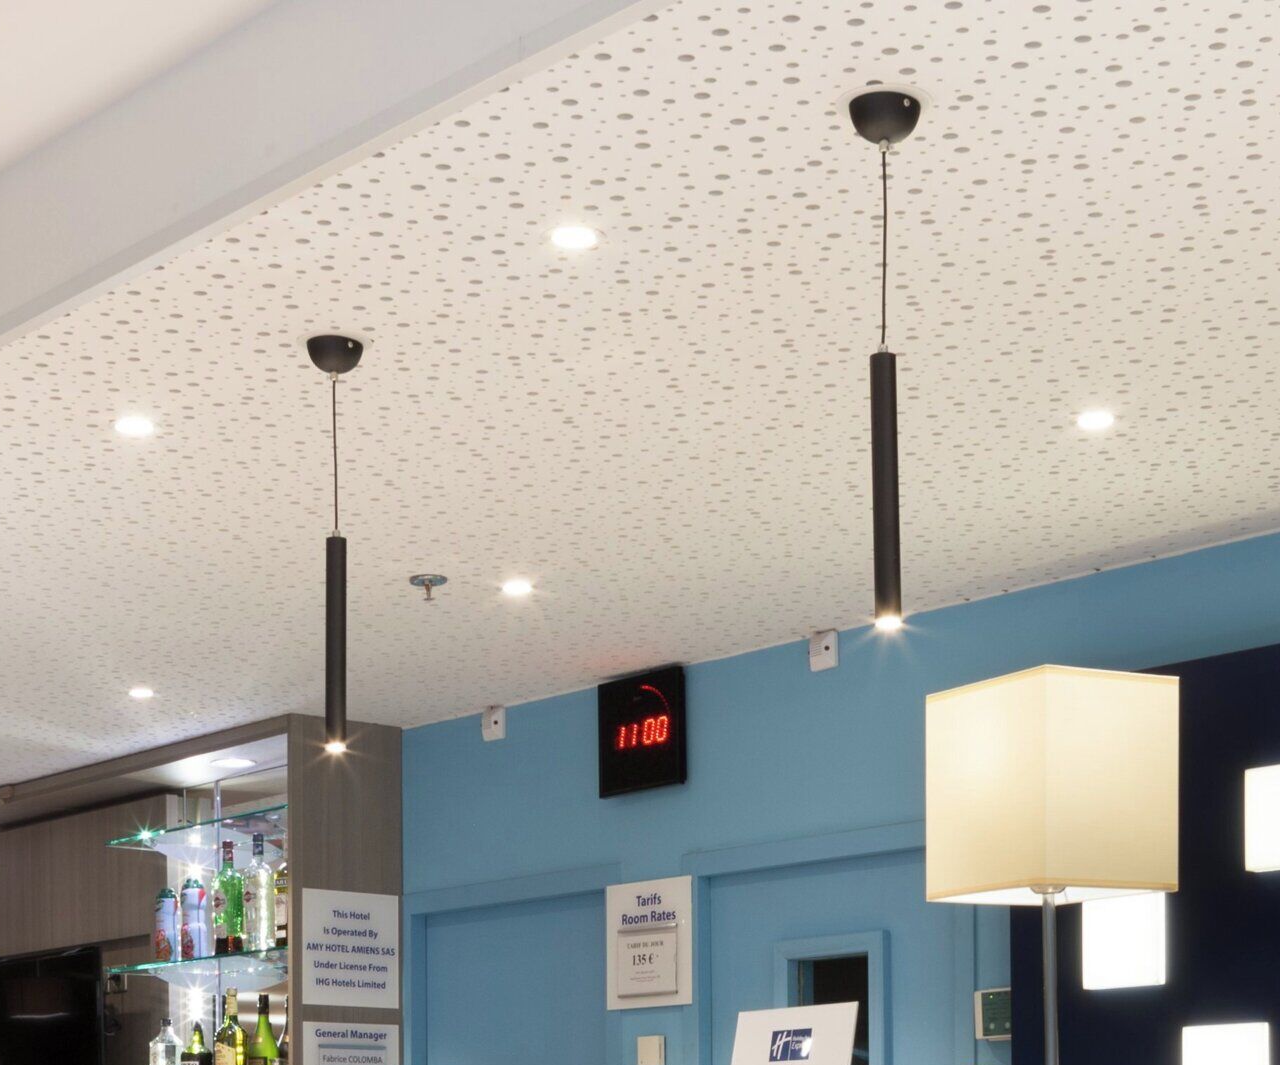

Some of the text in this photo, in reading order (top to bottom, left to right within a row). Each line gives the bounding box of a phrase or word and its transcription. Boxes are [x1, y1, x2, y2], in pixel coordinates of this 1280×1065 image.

[636, 893, 661, 907] Tarifs
[333, 910, 370, 920] This Hotel
[622, 910, 676, 925] Room Rates
[331, 927, 367, 937] Operated
[369, 930, 378, 940] By
[307, 943, 395, 956] AMY HOTEL AMIENS SAS
[632, 954, 647, 966] 135
[314, 961, 388, 972] Under License From
[316, 978, 386, 989] IHG Hotels Limited
[315, 1029, 387, 1041] General Manager
[323, 1055, 347, 1063] Fabrice
